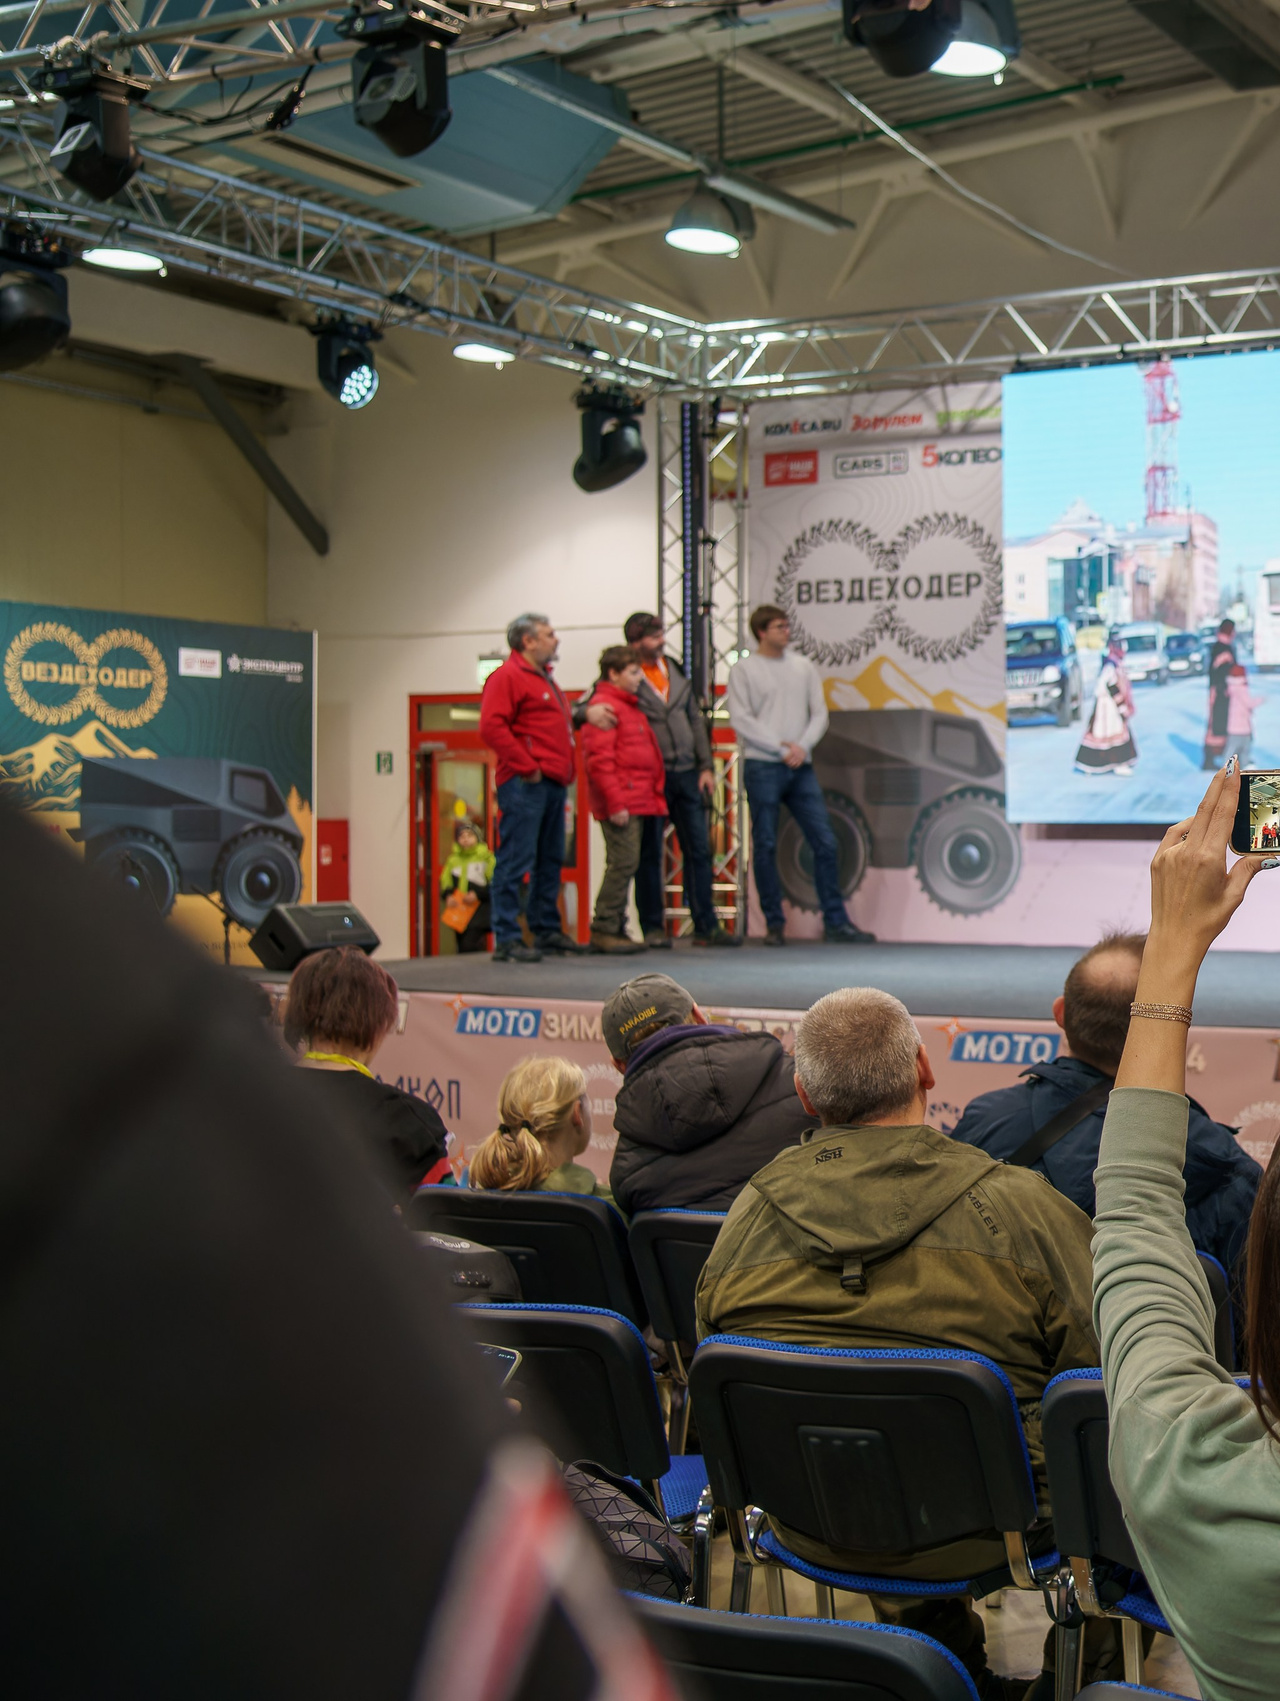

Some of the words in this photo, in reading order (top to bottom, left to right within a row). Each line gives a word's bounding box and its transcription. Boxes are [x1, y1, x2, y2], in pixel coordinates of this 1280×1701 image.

[796, 572, 983, 605] ВЕЗДЕХОДЕР
[21, 661, 153, 688] ВЕЗДЕХОДЕР
[465, 1008, 536, 1038] МОТО
[543, 1012, 605, 1042] ЗИМ
[961, 1033, 1053, 1064] МОТО
[965, 1191, 1000, 1238] MBLER
